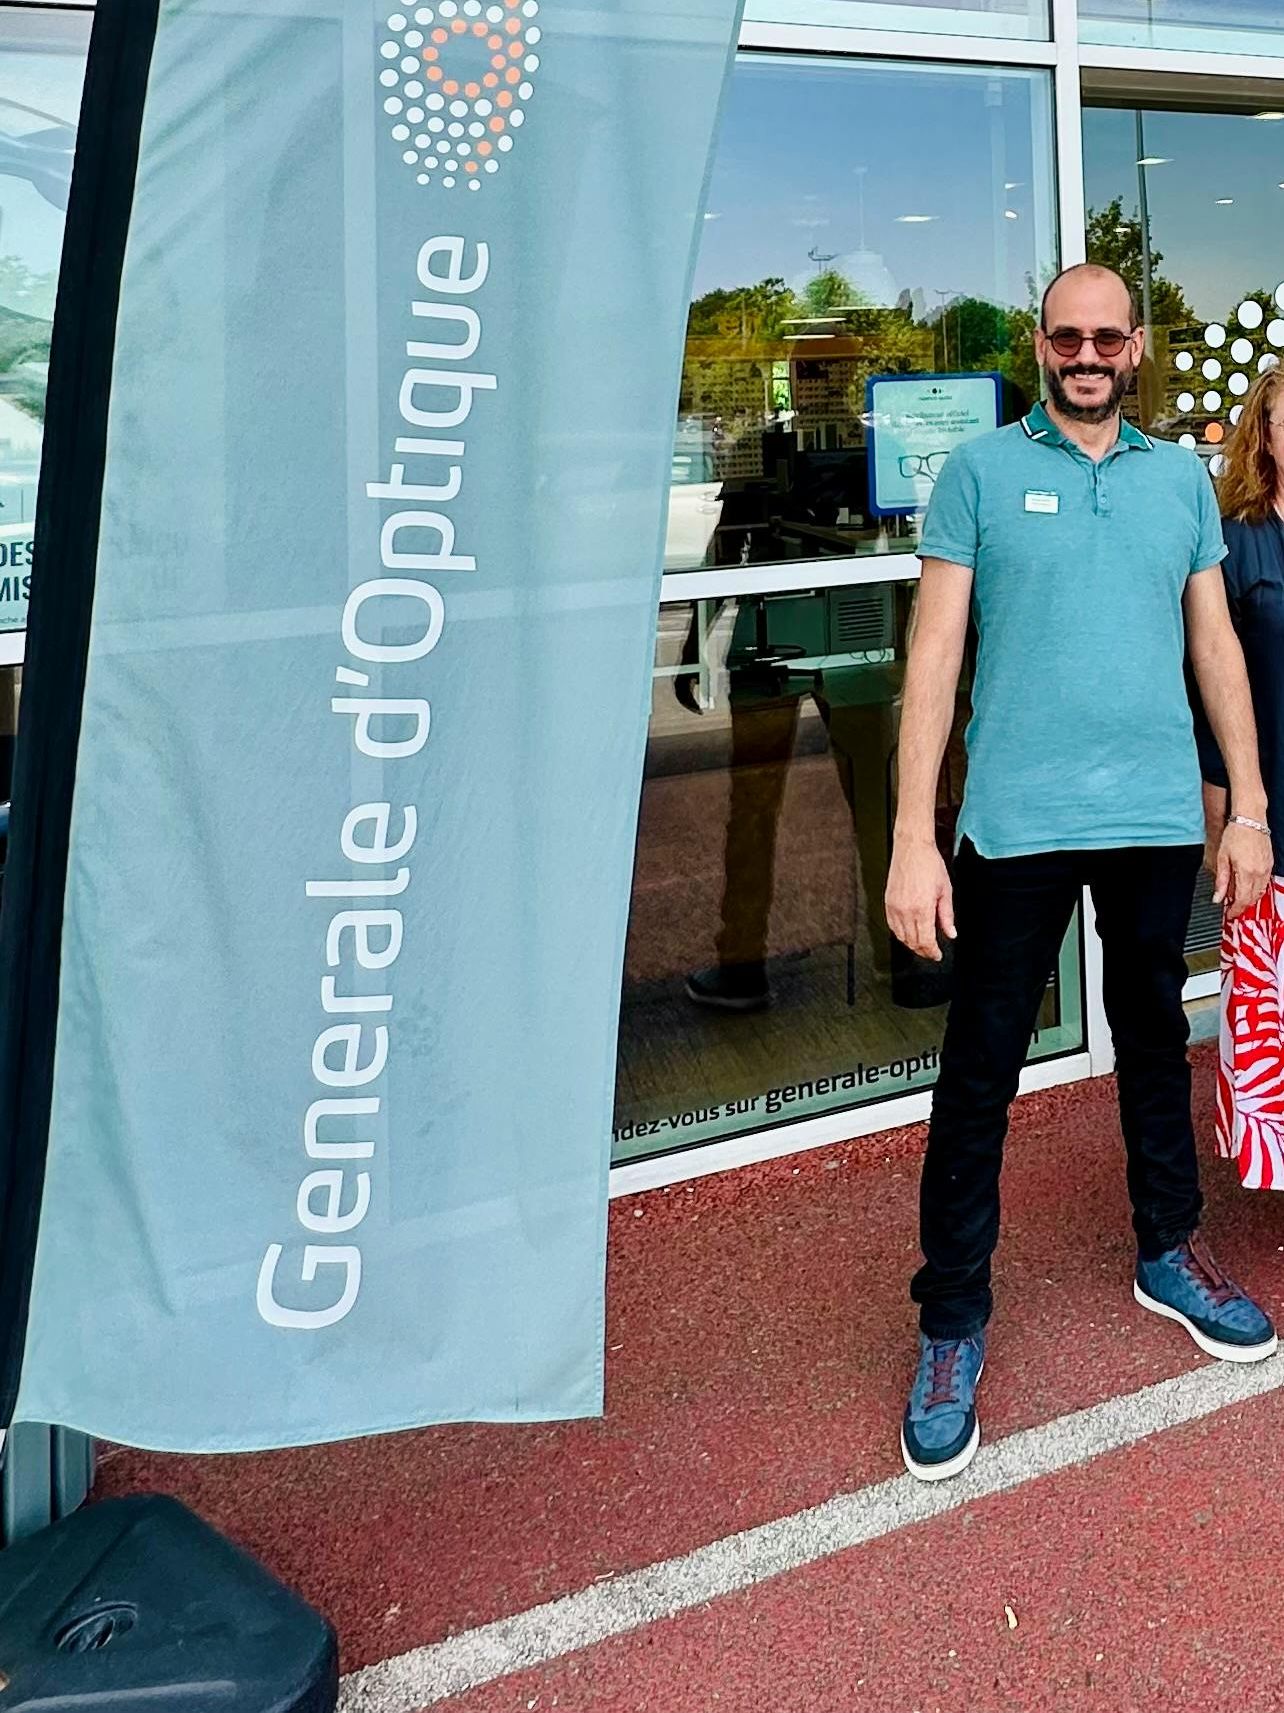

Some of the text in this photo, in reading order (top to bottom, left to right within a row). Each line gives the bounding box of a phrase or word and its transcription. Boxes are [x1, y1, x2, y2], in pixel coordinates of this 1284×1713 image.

[255, 235, 498, 1331] Generale d'Optique
[725, 1095, 760, 1117] sur
